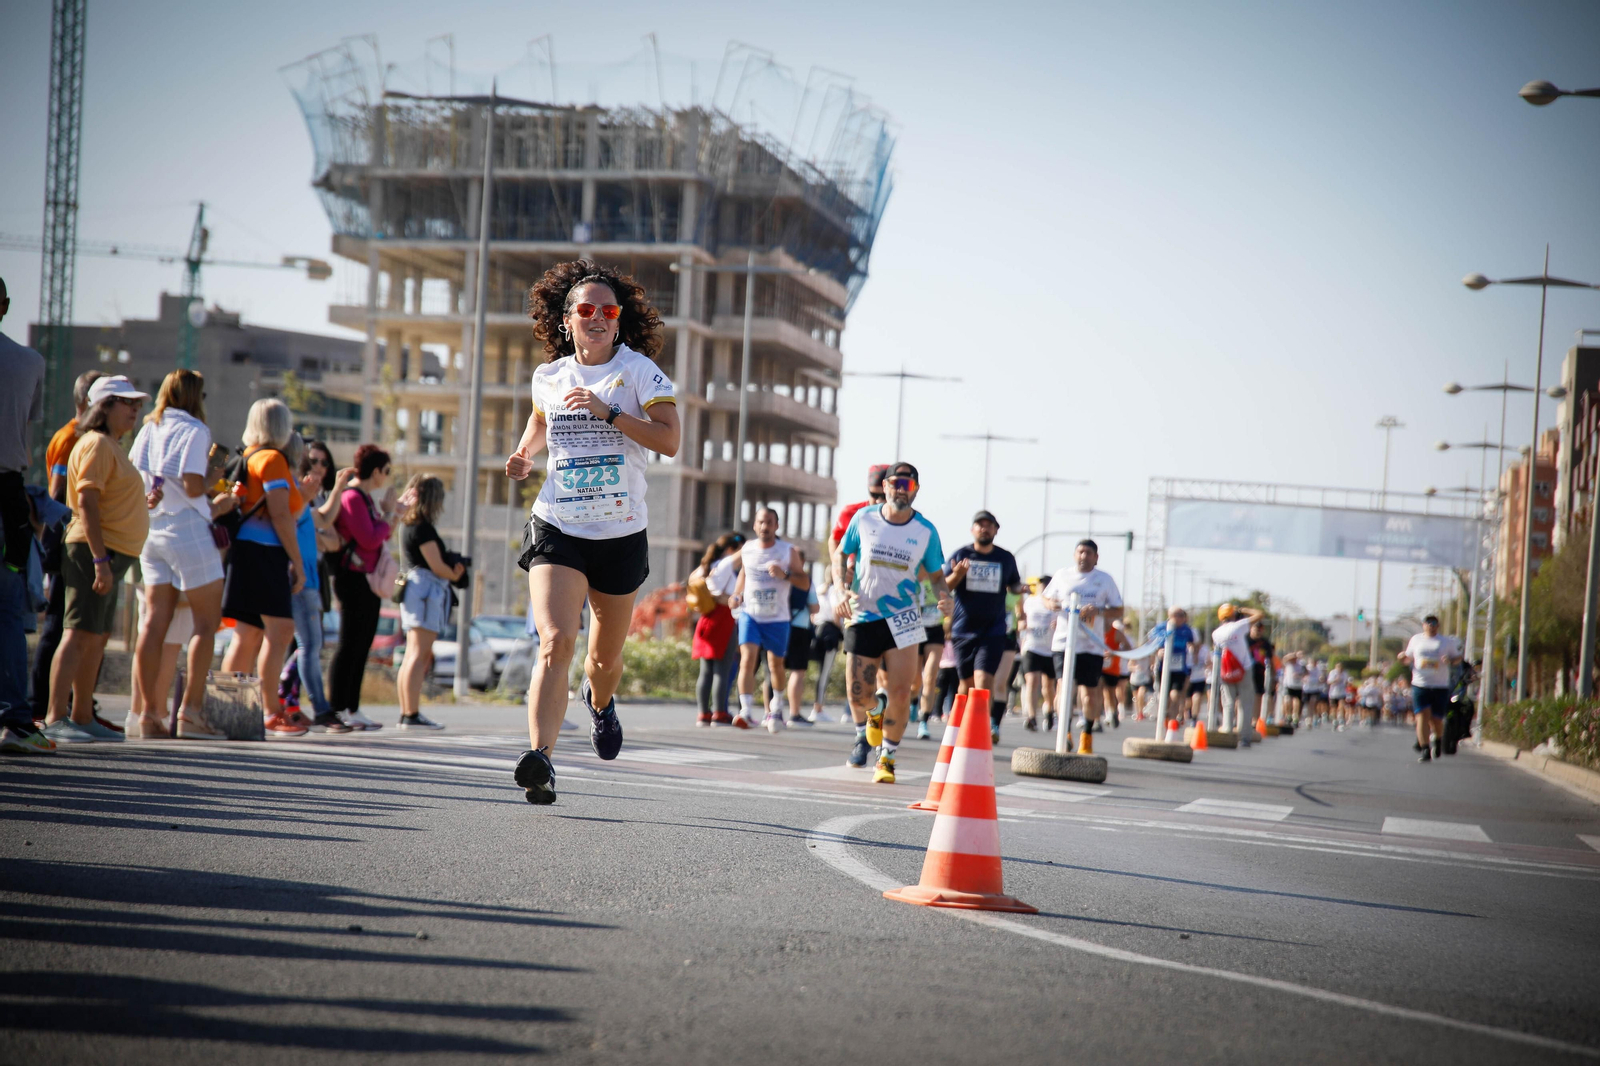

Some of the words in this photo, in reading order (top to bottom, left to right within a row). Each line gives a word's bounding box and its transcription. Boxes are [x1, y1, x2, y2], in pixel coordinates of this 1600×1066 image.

[562, 465, 620, 490] 5223
[577, 486, 603, 494] NATALIA
[893, 551, 910, 562] 2022
